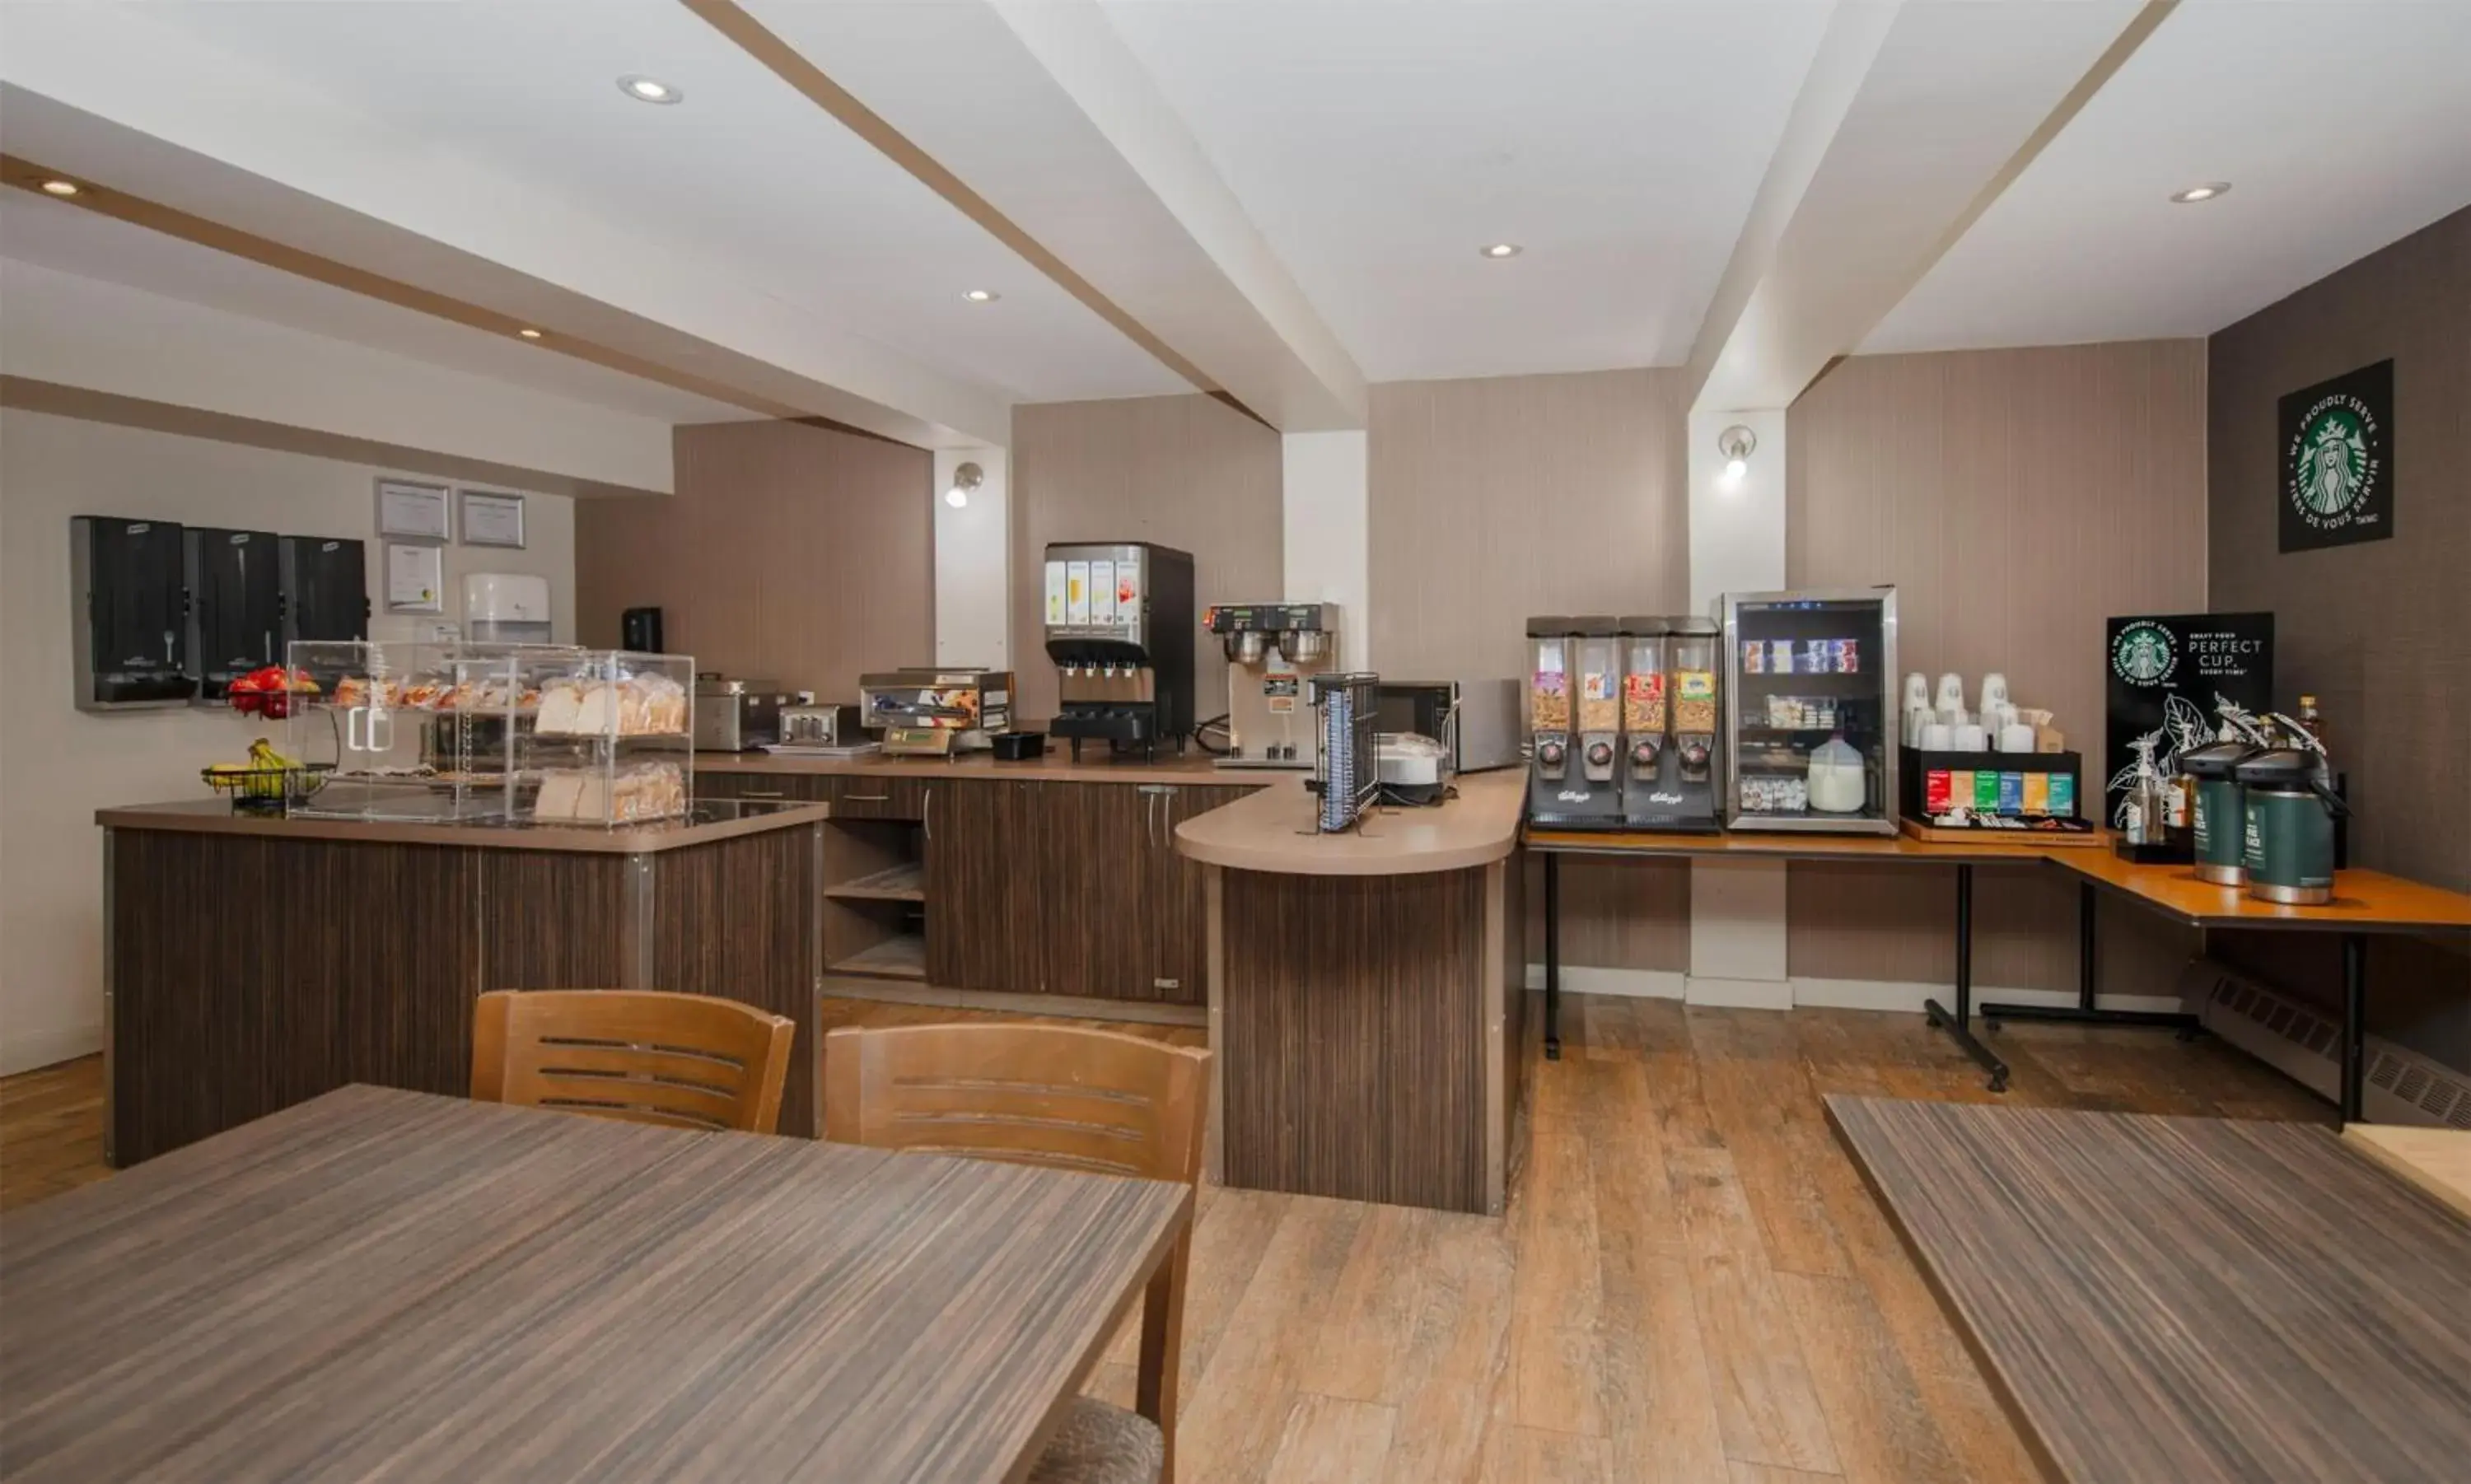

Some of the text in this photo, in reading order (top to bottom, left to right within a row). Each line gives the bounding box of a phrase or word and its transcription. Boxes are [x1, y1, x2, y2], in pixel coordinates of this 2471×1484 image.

[2300, 394, 2347, 431] PROUDLY
[2349, 396, 2378, 434] SERVE
[2305, 513, 2320, 528] DE
[2322, 511, 2352, 530] VOUS
[2188, 640, 2263, 653] PERFECT
[2198, 655, 2238, 668] CUP.
